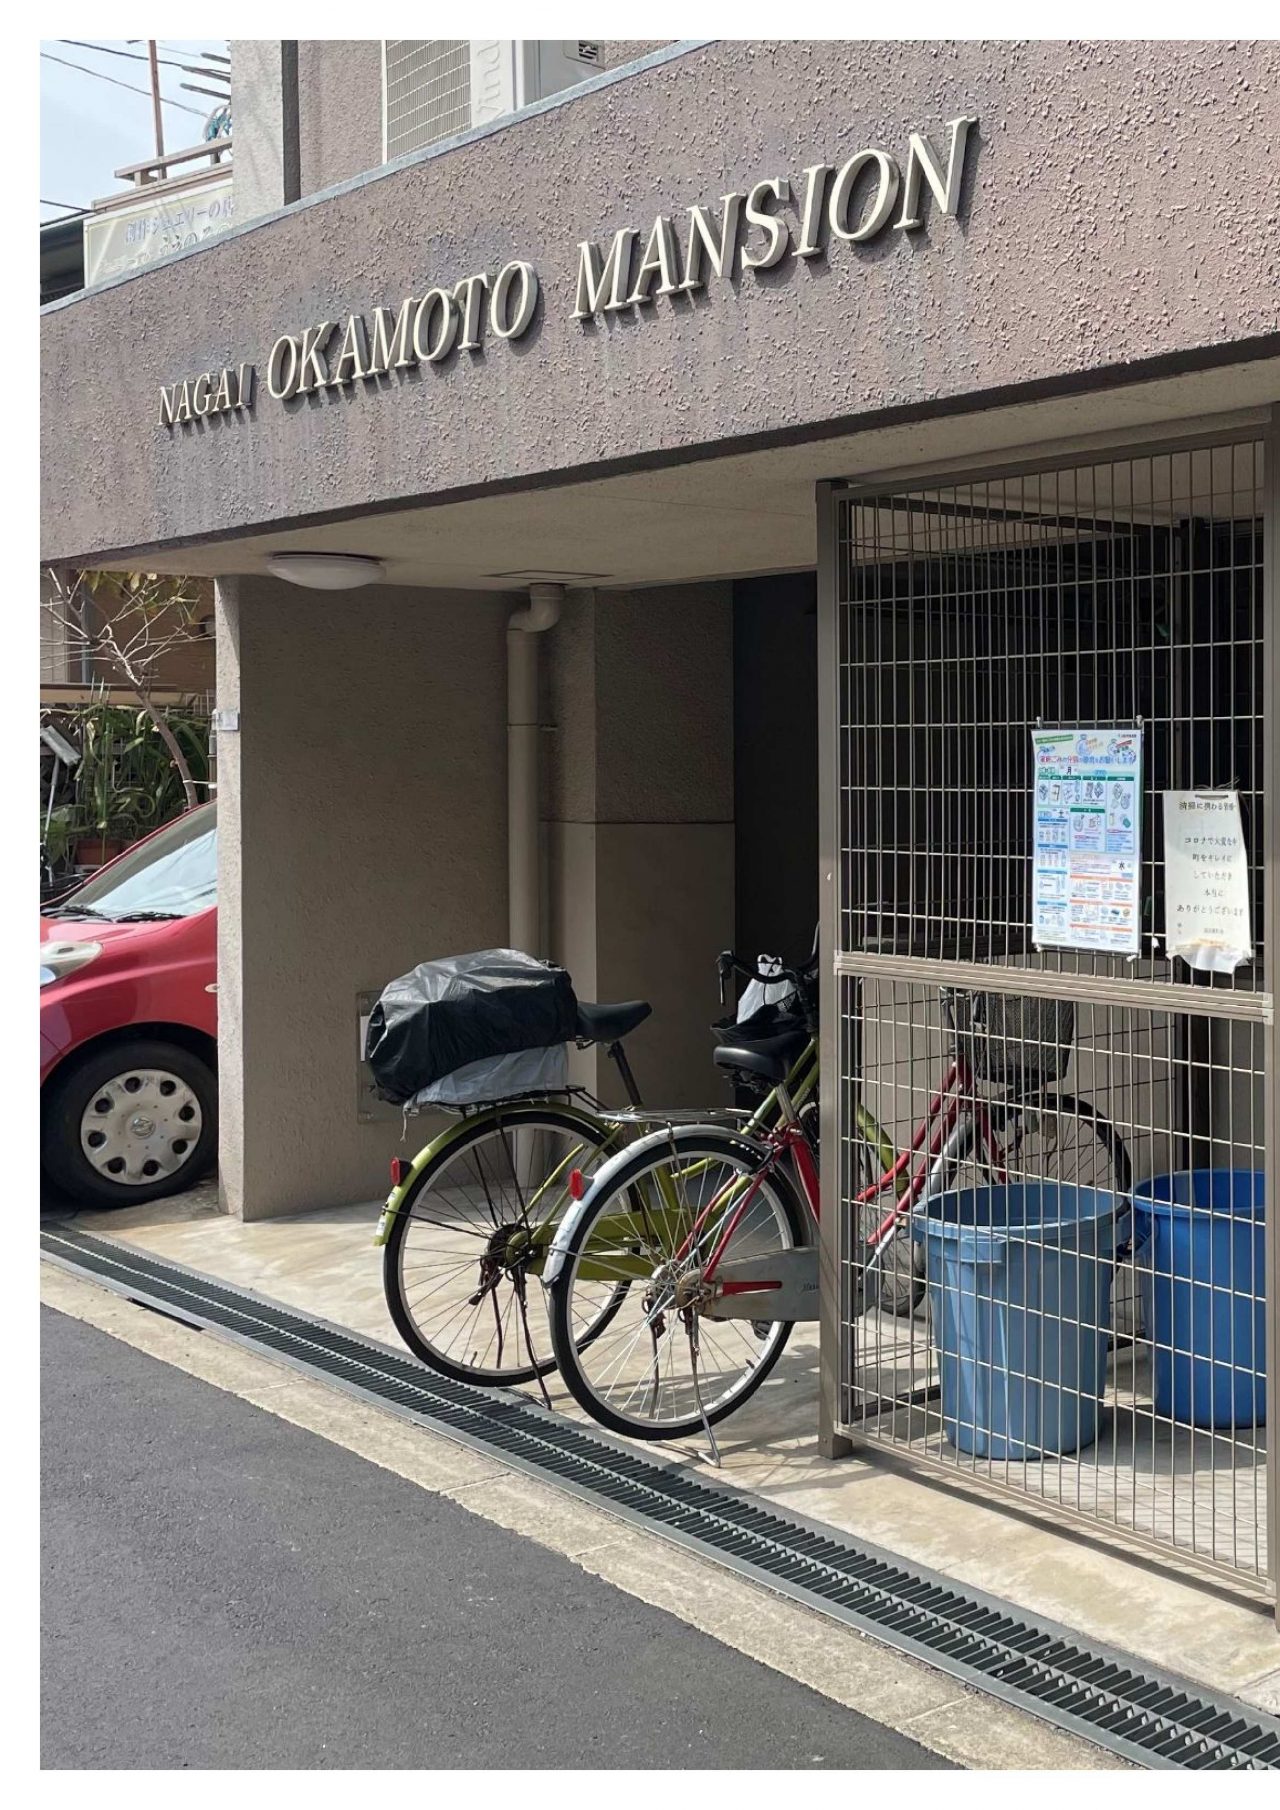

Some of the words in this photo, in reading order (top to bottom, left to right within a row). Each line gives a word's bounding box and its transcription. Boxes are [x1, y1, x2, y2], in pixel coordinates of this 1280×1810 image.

[158, 362, 254, 426] NAGAI
[267, 260, 538, 400] OKAMOTO
[569, 115, 977, 319] MANSION
